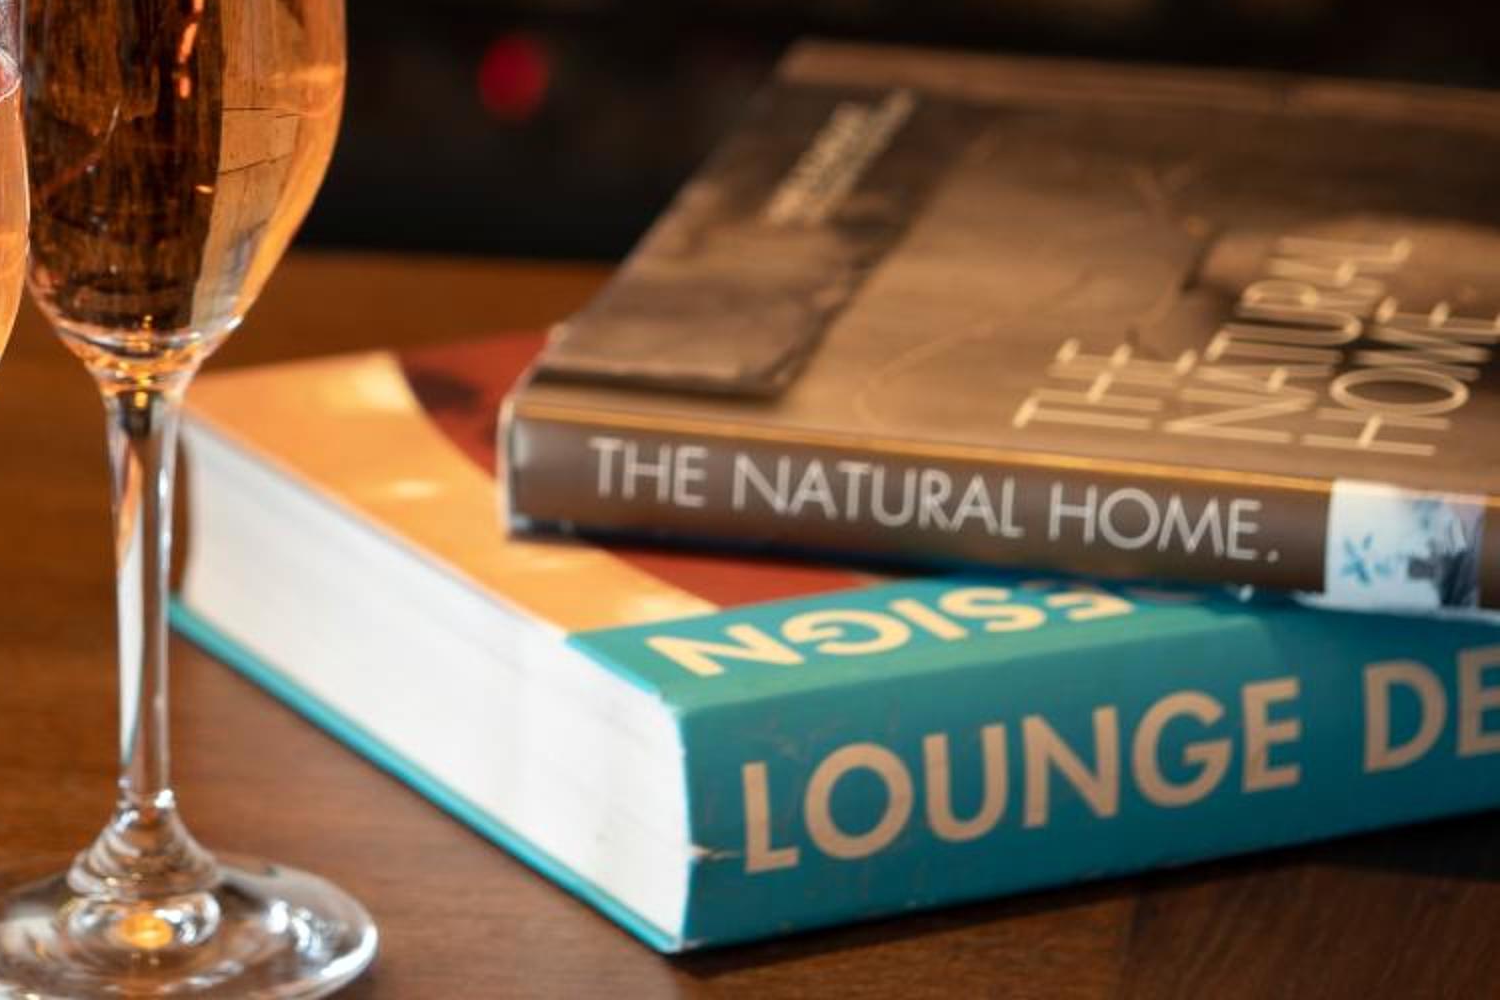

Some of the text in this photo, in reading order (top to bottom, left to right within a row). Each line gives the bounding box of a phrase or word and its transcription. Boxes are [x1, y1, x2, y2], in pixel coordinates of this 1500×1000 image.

[1013, 336, 1198, 431] THE
[1163, 237, 1413, 444] NATURAL
[1302, 296, 1500, 456] HOME
[589, 436, 1280, 563] THE NATURAL HOME.
[644, 586, 1204, 677] ESIGN
[742, 646, 1500, 873] LOUNGE DE
